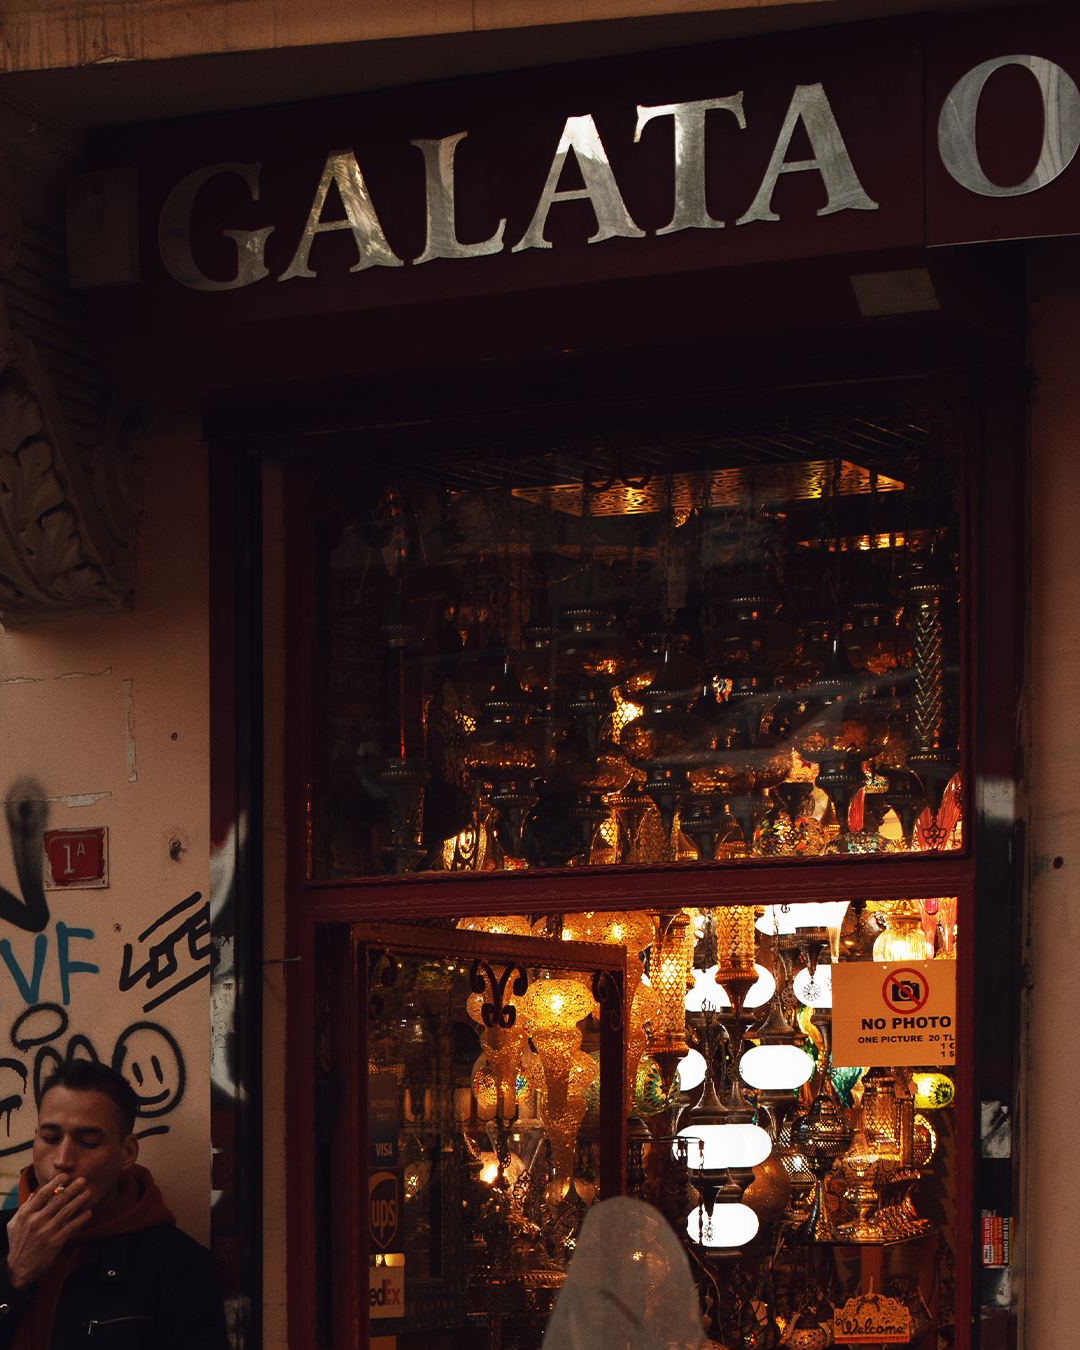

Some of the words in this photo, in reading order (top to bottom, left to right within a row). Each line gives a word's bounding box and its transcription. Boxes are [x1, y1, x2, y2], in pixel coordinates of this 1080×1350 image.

[157, 82, 881, 292] GALATA
[861, 1018, 886, 1031] NO
[892, 1016, 952, 1030] PHOTO
[858, 1036, 878, 1044] ONE
[881, 1035, 923, 1043] PICTURE
[929, 1034, 940, 1042] 20
[374, 1142, 394, 1157] VISA
[371, 1199, 396, 1239] ups
[370, 1279, 401, 1307] edEx
[835, 1317, 905, 1335] Welcome
